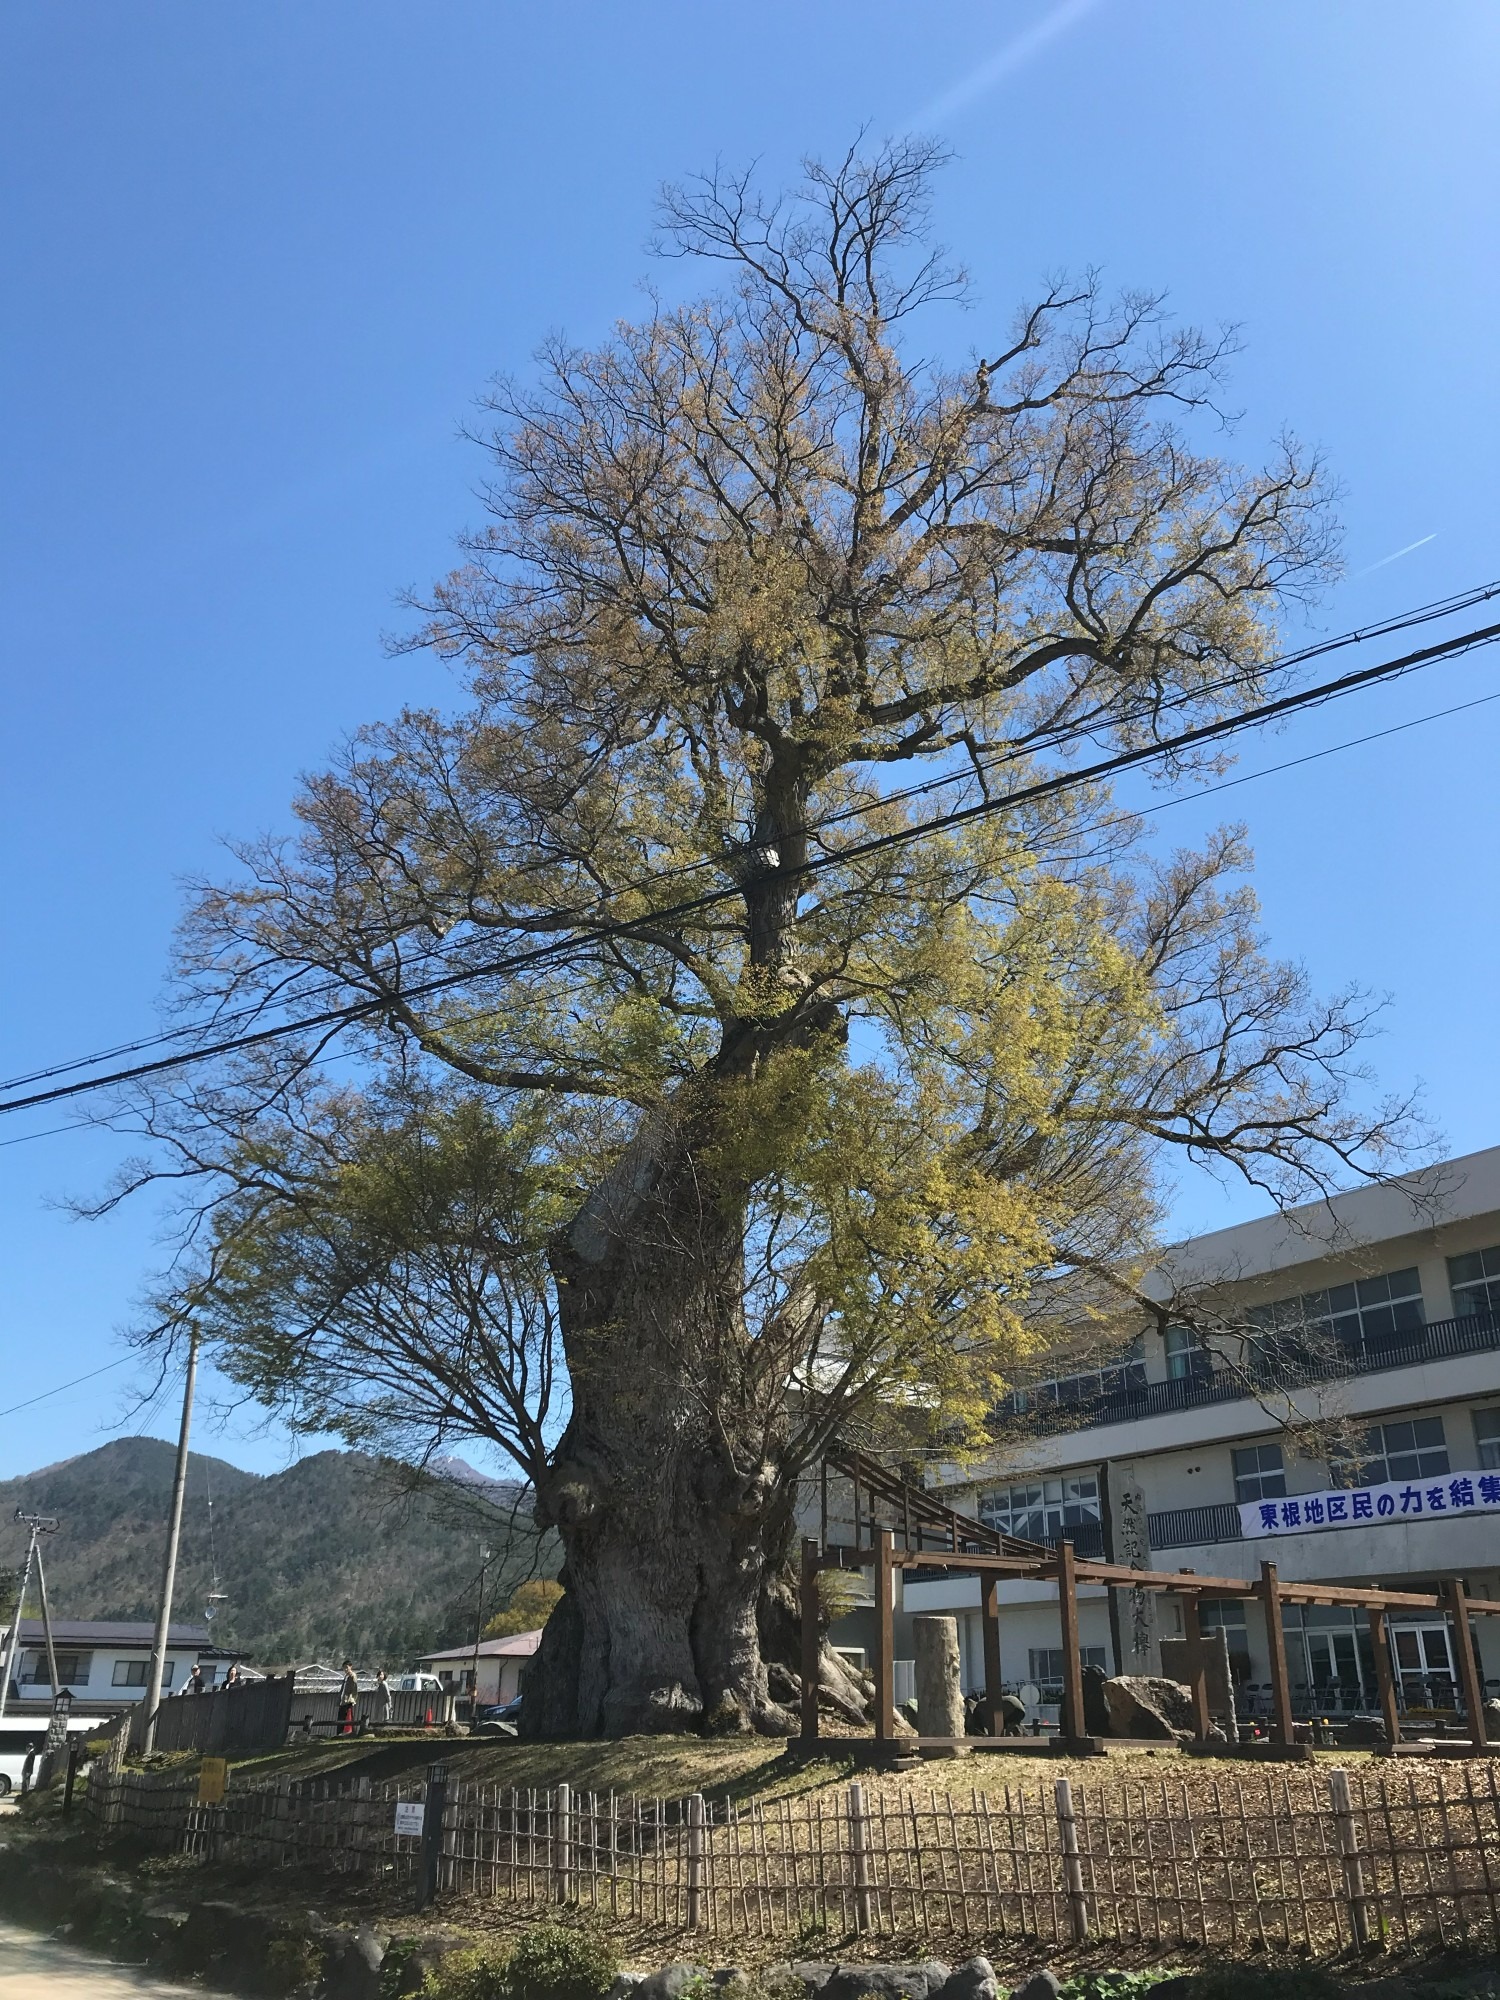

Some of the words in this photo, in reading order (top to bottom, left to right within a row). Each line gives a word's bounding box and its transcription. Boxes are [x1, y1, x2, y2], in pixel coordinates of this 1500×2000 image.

[1259, 1476, 1500, 1530] 東根地区民の力を結集
